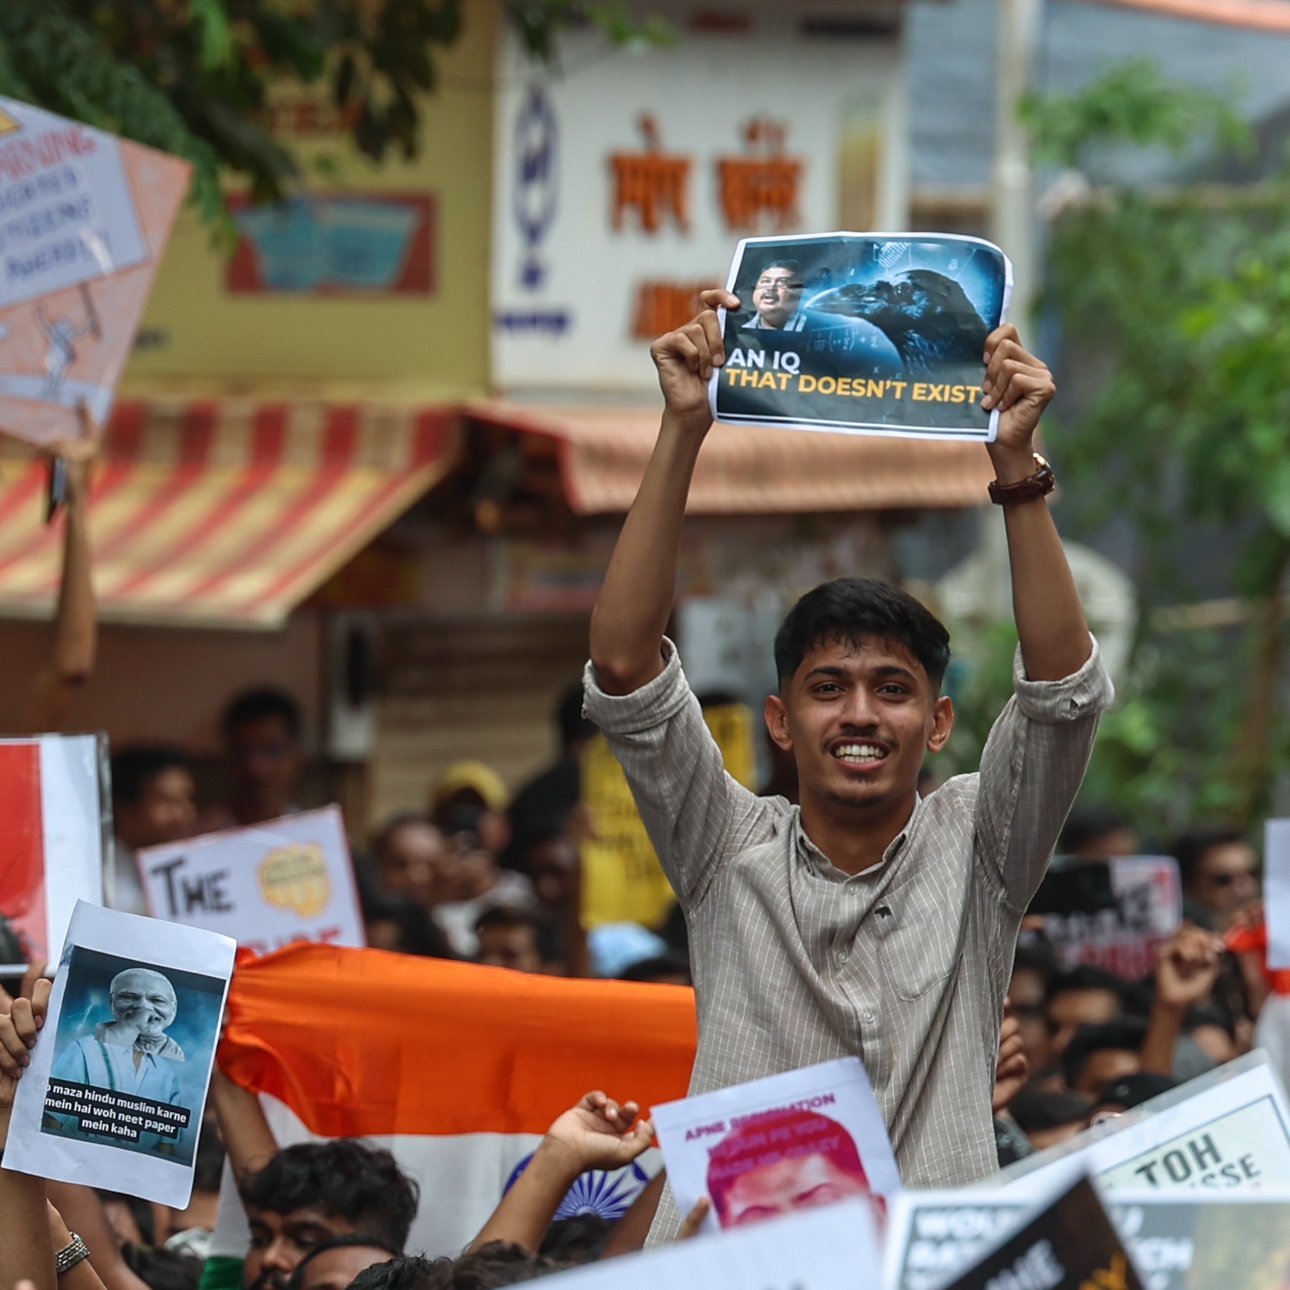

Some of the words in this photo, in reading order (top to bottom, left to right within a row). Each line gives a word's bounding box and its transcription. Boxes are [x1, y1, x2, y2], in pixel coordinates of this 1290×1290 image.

[725, 347, 765, 369] AN
[772, 351, 801, 375] IQ
[725, 368, 793, 392] THAT
[798, 374, 908, 400] DOESN'T
[912, 382, 983, 404] EXIST
[149, 853, 236, 919] THE
[44, 1097, 72, 1111] mein
[74, 1102, 92, 1115] hai
[93, 1107, 117, 1120] woh
[118, 1112, 143, 1126] neet
[144, 1119, 176, 1133] paper
[53, 1085, 83, 1098] maza
[84, 1090, 116, 1105] hindu
[117, 1098, 155, 1115] muslim
[157, 1106, 187, 1123] karne
[684, 1121, 726, 1142] APNE
[730, 1092, 836, 1129] RESIGNATION
[81, 1119, 109, 1132] mein
[111, 1124, 137, 1138] kaha
[1134, 1133, 1222, 1188] TOH
